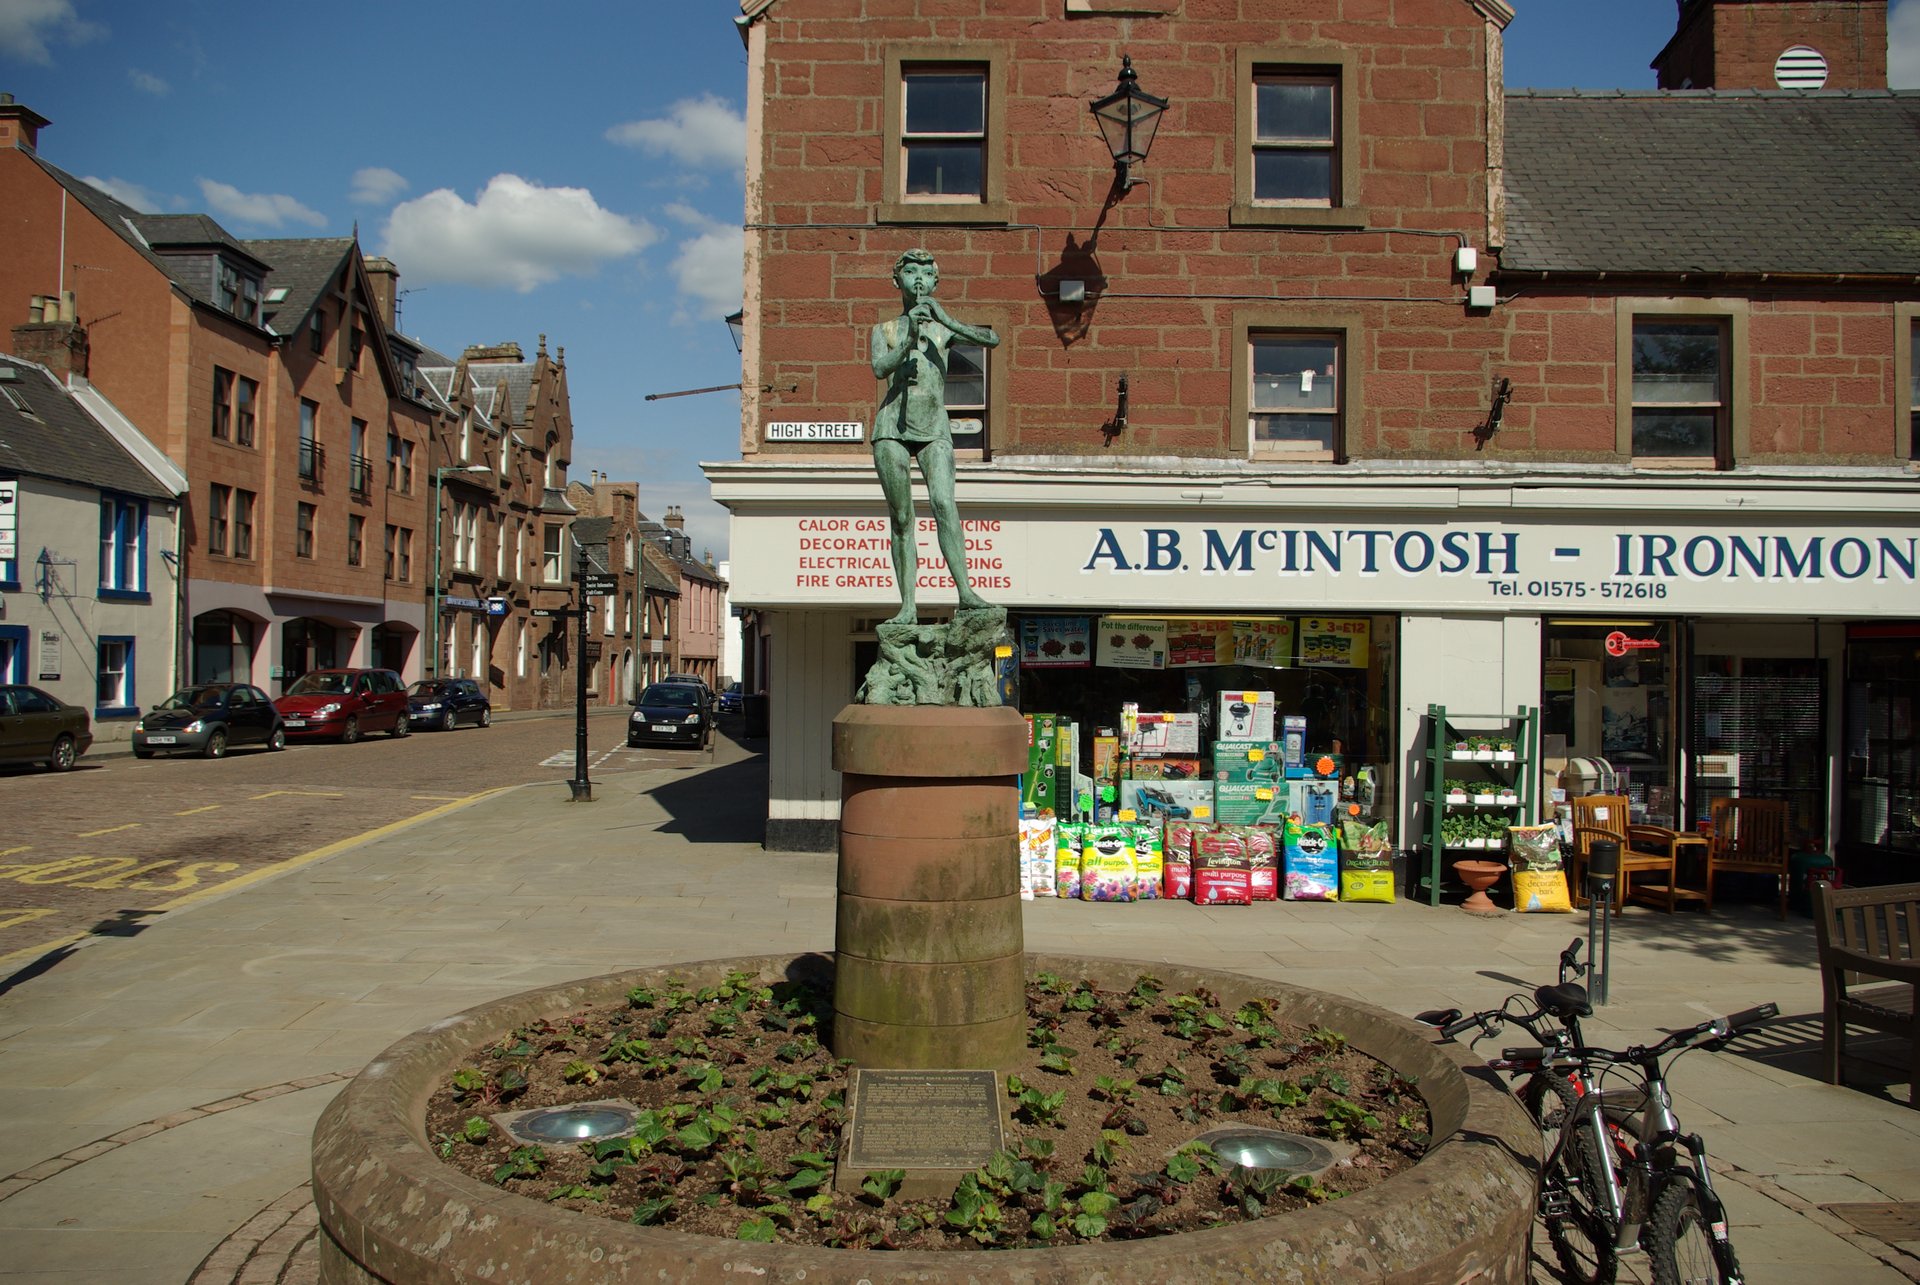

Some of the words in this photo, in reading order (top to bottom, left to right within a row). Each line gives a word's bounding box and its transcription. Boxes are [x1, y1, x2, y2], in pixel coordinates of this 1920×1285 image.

[771, 424, 802, 437] HIGH
[808, 424, 858, 438] STREET
[799, 520, 849, 531] CALOR
[855, 520, 885, 531] GAS
[918, 520, 1001, 532] SEICING
[1083, 528, 1188, 570] A.B.
[1615, 534, 1918, 579] IRONMON
[799, 557, 891, 569] ELECTRICAL
[917, 557, 1003, 570] PLUBING
[797, 575, 829, 587] FIRE
[836, 576, 893, 588] GRATES
[1488, 581, 1522, 596] Tel.
[1527, 581, 1586, 597] 01575
[1601, 582, 1667, 598] 572618
[1101, 621, 1115, 629] Pot
[1117, 621, 1127, 630] the
[1128, 622, 1165, 632] difference!
[1087, 857, 1102, 866] all
[1207, 857, 1241, 867] Levington
